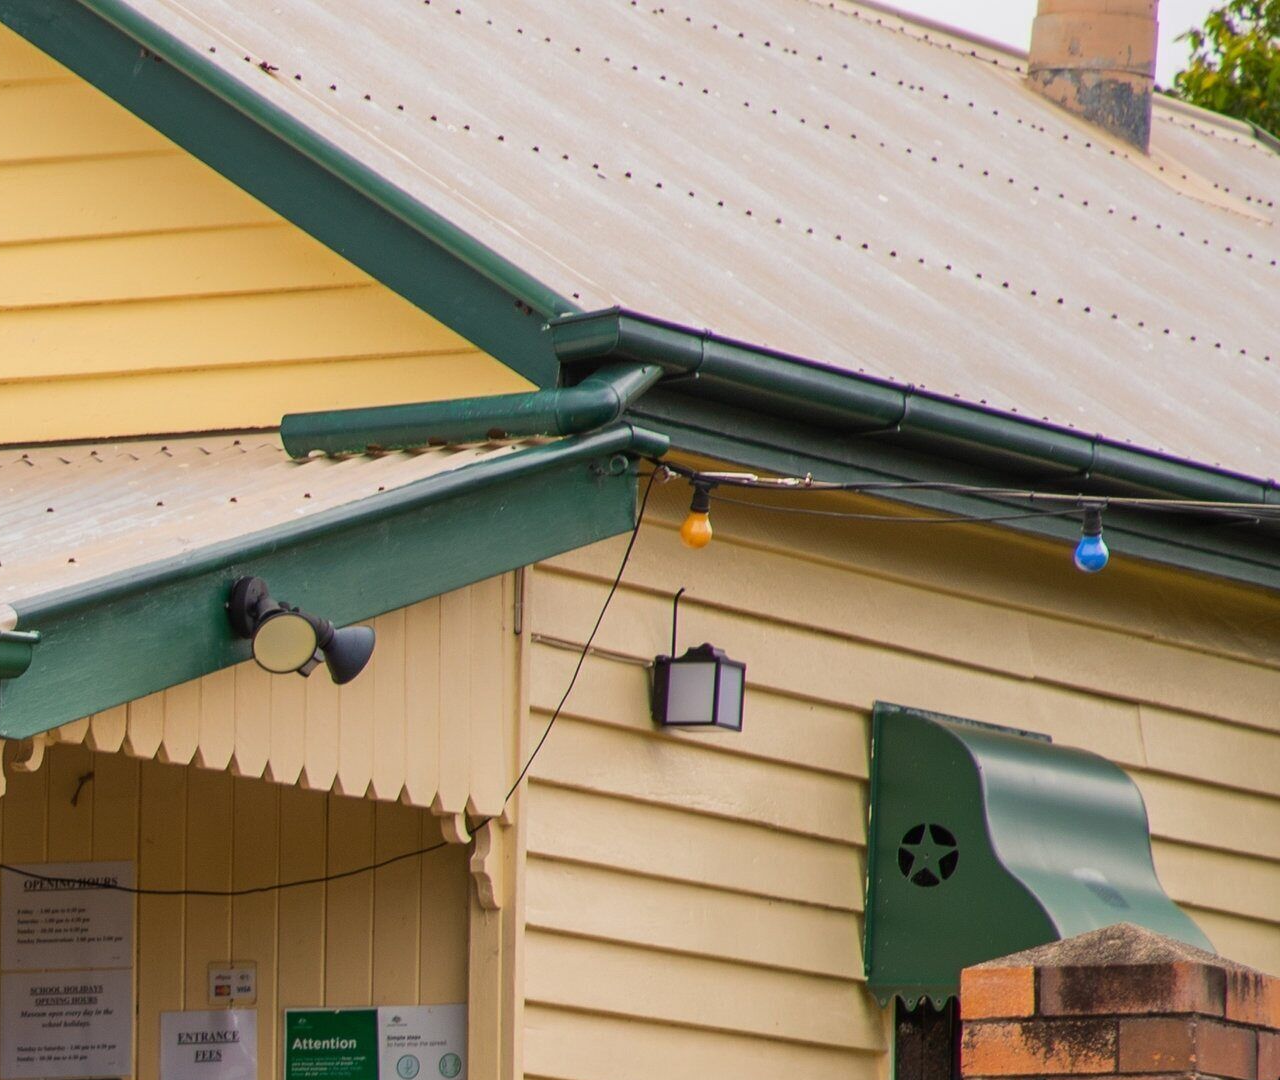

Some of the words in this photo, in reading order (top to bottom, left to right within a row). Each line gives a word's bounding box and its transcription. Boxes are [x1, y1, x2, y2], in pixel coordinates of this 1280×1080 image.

[178, 1030, 240, 1044] ENTRANCE
[292, 1036, 357, 1050] Attention
[194, 1049, 223, 1062] FEES
